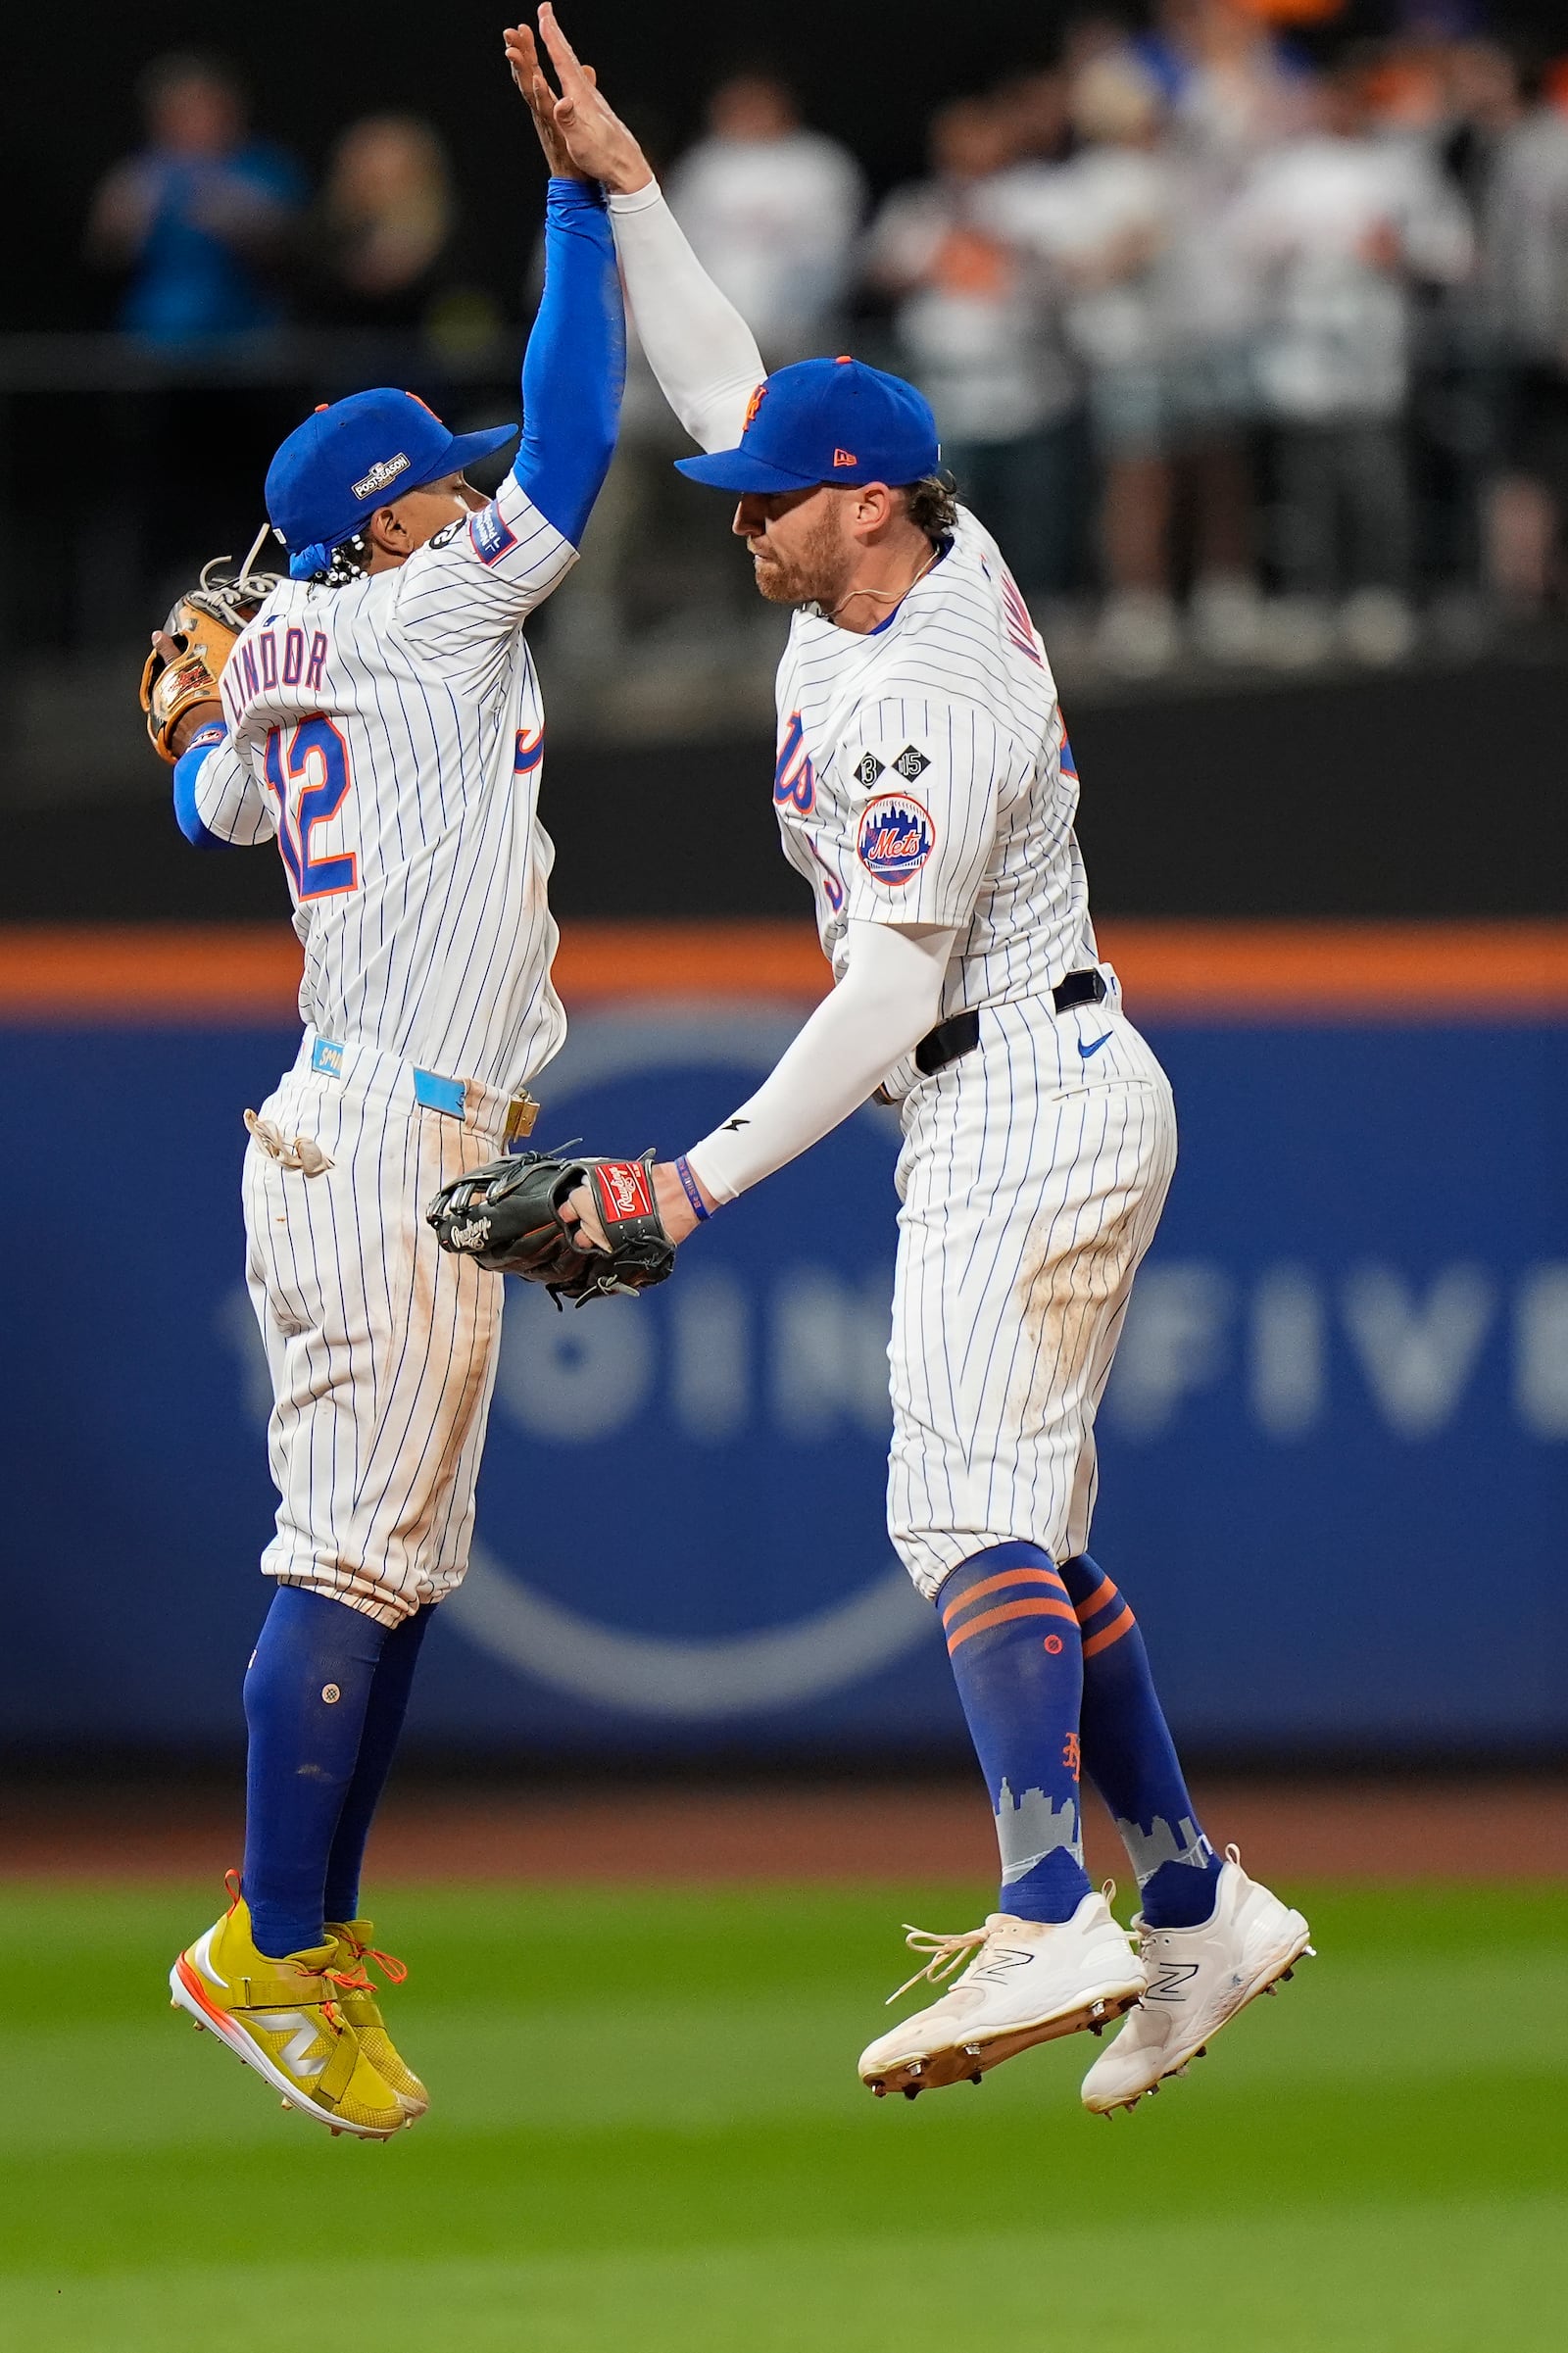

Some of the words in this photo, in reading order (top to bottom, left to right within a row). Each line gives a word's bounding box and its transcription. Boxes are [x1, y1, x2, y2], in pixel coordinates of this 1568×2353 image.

[355, 457, 409, 498] POSTSEASON
[222, 627, 329, 727] LINDOR
[860, 755, 877, 787] 3
[898, 752, 922, 776] 15
[264, 711, 359, 904] 12
[867, 827, 923, 860] Mets
